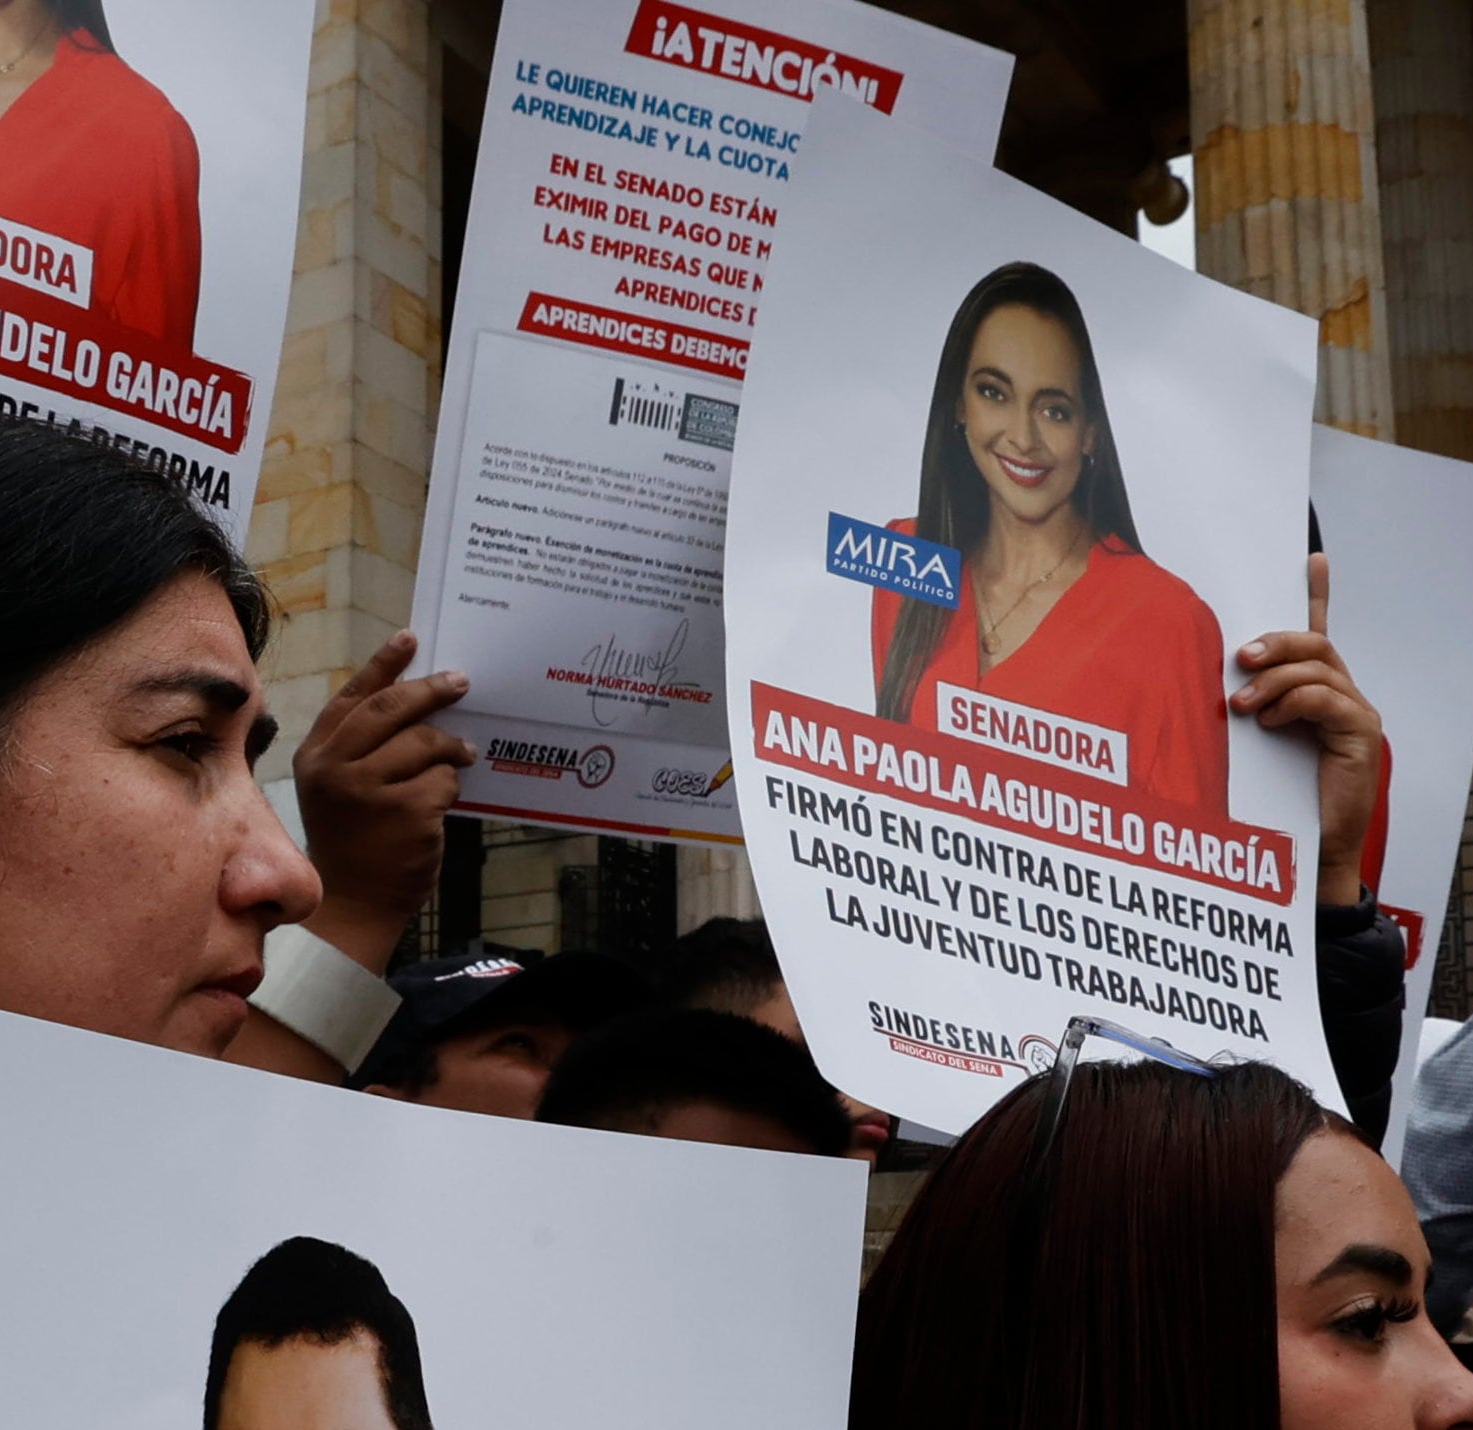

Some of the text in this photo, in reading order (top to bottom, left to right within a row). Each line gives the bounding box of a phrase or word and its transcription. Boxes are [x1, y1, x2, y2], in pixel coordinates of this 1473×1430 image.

[516, 61, 713, 130] LE QUIEREN HACER
[512, 93, 790, 182] APRENDIZAJE Y LA CUOTA
[533, 185, 609, 221] EXIMIR
[614, 204, 652, 232] DEL
[658, 214, 722, 247] PAGO
[727, 232, 752, 257] DE
[549, 153, 778, 228] EN EL SENADO ESTÁN
[543, 222, 585, 251] LAS
[590, 234, 702, 278] EMPRESAS
[707, 262, 748, 292] QUE
[532, 302, 667, 350] APRENDICES
[614, 276, 744, 324] APRENDICES
[105, 351, 233, 439] GARCÍA
[833, 558, 955, 601] PARTIDO POLÍTICO
[834, 527, 953, 589] MIRA
[546, 667, 657, 695] NORMA HURTADO
[487, 738, 578, 768] SINDESENA
[951, 696, 1116, 774] SENADORA
[763, 709, 1282, 893] ANA PAOLA AGUDELO GARCÍA
[765, 775, 1294, 959] FIRMÓ EN CONTRA DE LA REFORMA
[789, 828, 1283, 1002] LABORAL Y DE LOS DERECHOS DE
[826, 886, 1270, 1043] LA JUVENTUD TRABAJADORA
[868, 1000, 1016, 1062] SINDESENA
[891, 1039, 999, 1077] SINDICATO DEL SENA
